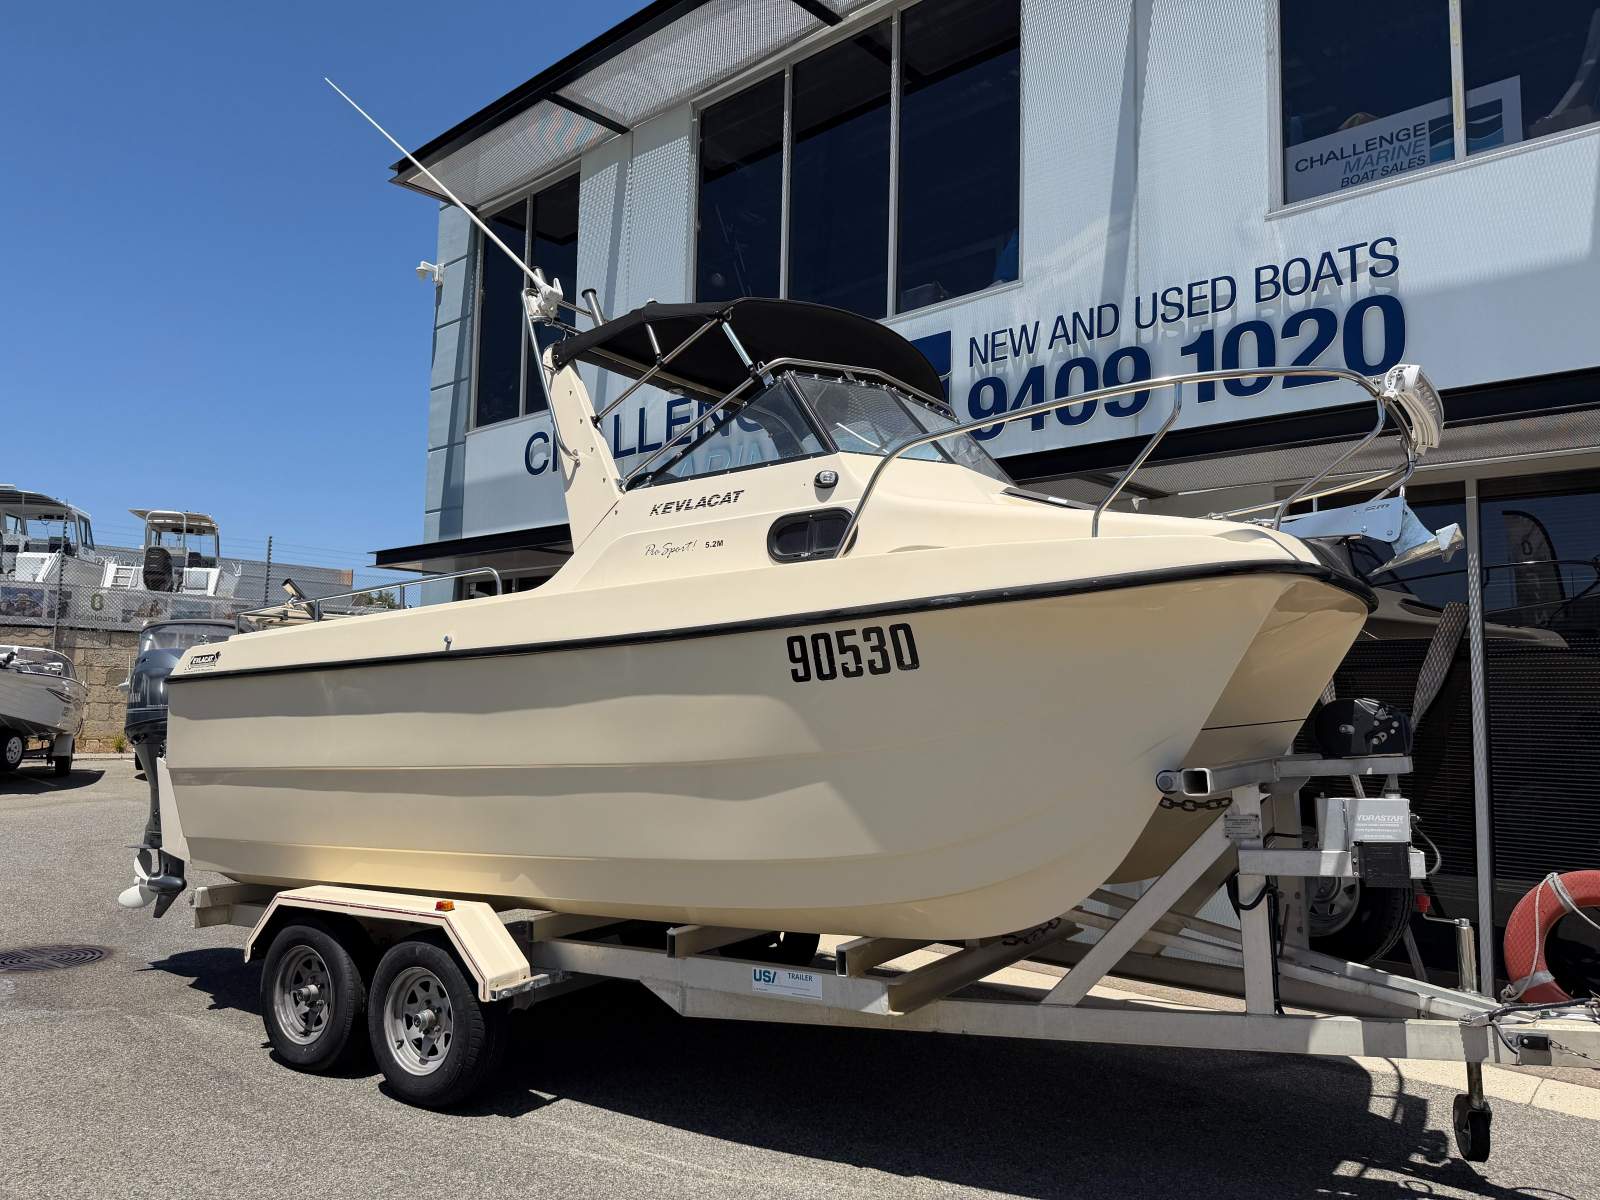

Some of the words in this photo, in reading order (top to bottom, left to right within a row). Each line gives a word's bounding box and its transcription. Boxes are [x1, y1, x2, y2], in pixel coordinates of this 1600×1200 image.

[1295, 122, 1426, 172] CHALLENGE
[1344, 138, 1425, 174] MARINE
[1341, 168, 1376, 188] BOAT
[1381, 155, 1426, 176] SALES
[969, 321, 1040, 367] NEW
[1048, 303, 1120, 350] AND
[1135, 275, 1237, 329] USED
[1255, 236, 1400, 303] BOATS
[967, 346, 1151, 440] 9409
[1180, 294, 1406, 403] 1020
[649, 489, 745, 517] KEVLACAT
[705, 540, 724, 549] 5.2M
[786, 622, 920, 683] 90530
[788, 972, 813, 982] TRAILER
